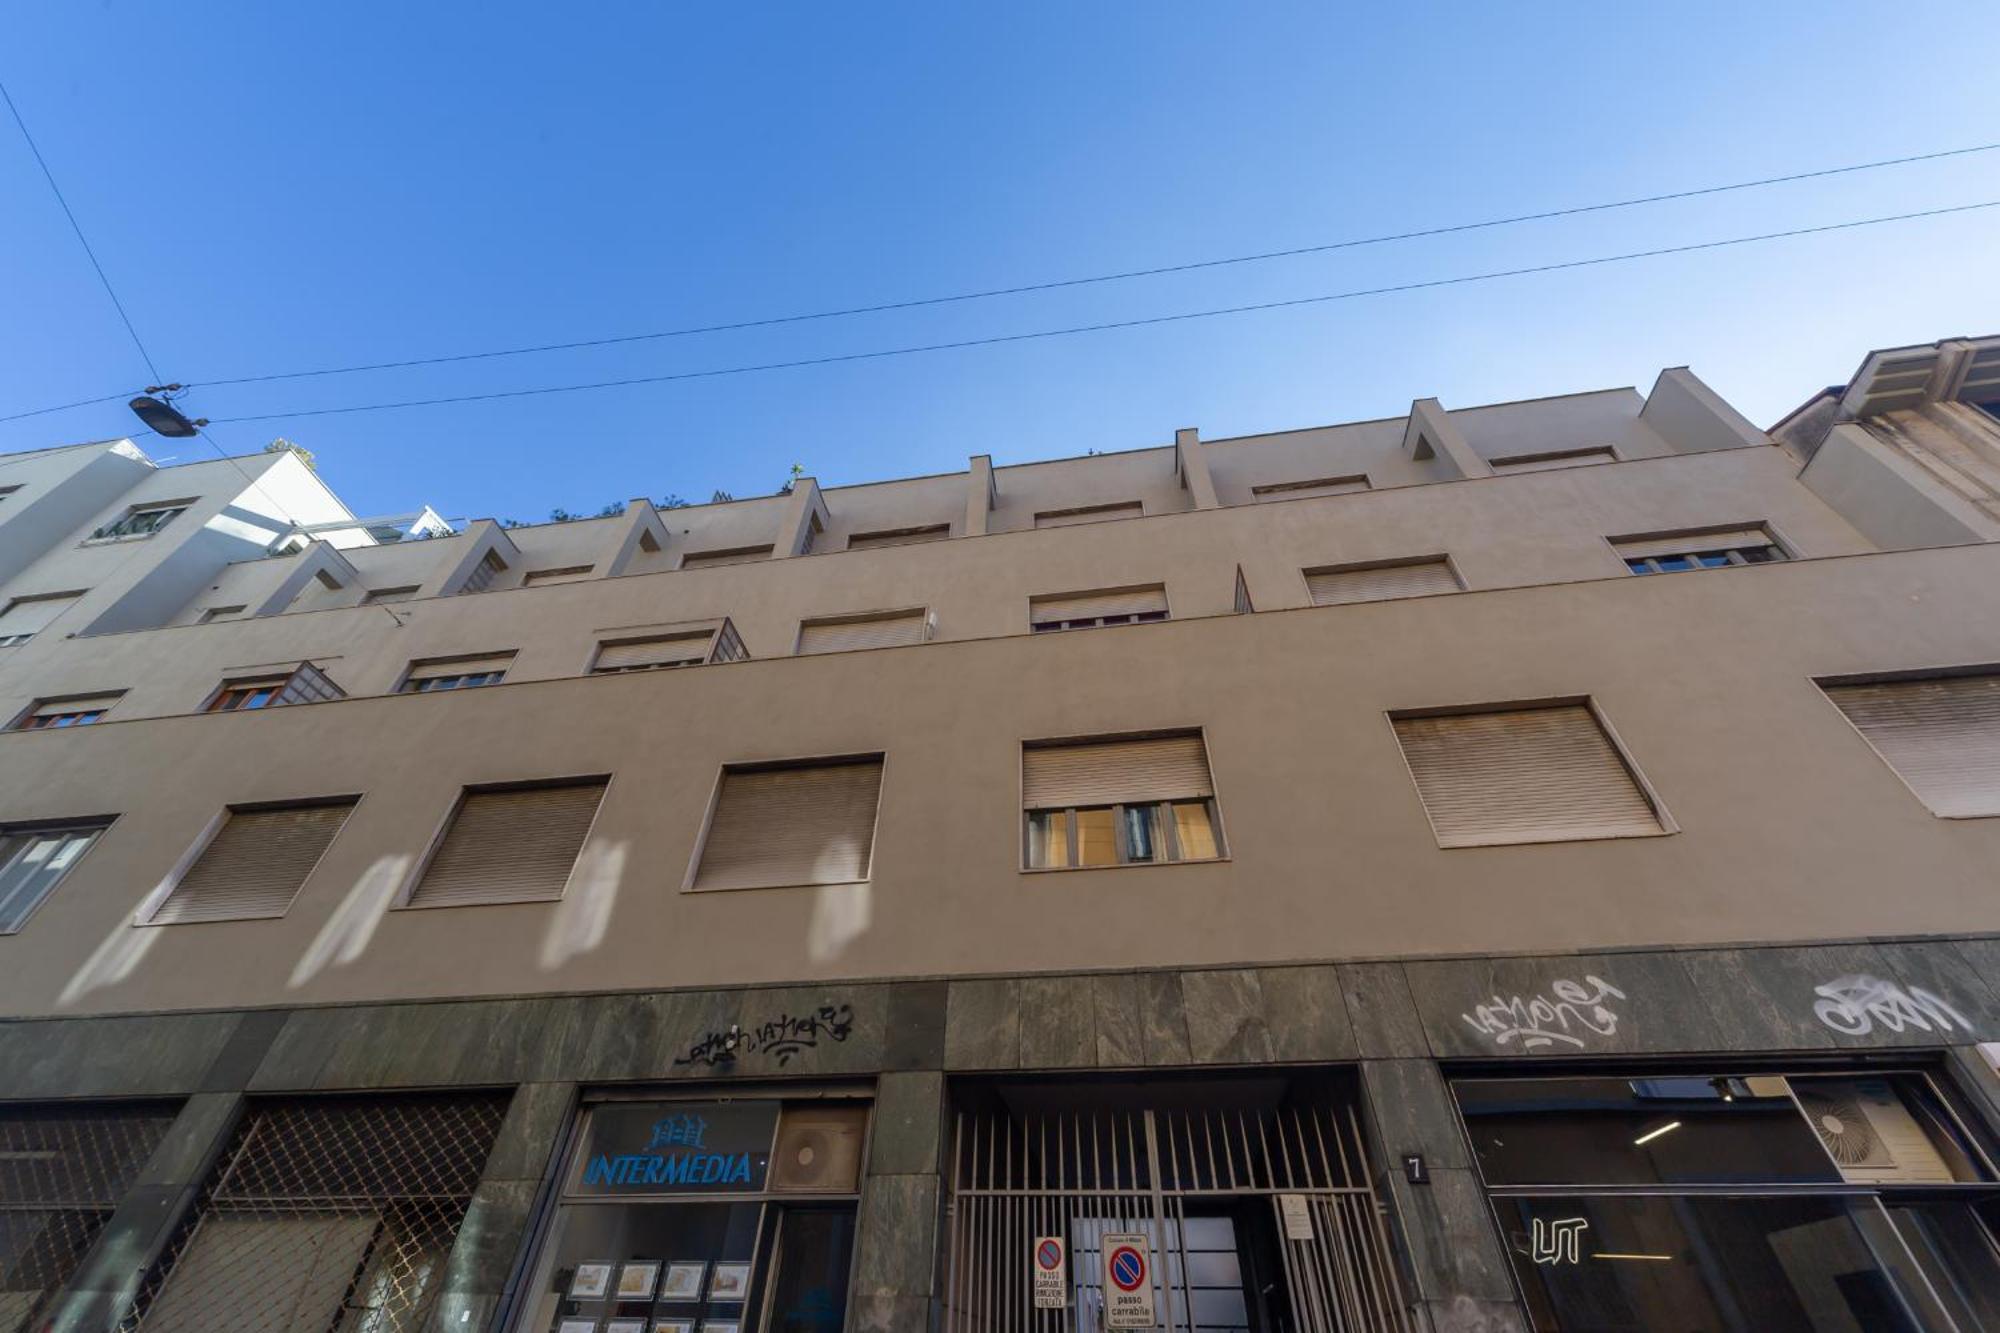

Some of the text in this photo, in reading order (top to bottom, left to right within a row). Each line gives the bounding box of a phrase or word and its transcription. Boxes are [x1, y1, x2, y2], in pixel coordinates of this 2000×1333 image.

[583, 1152, 750, 1185] INTERMEDIA
[1408, 1158, 1420, 1178] 7
[1117, 1296, 1142, 1305] passo
[1111, 1306, 1150, 1316] carrabile
